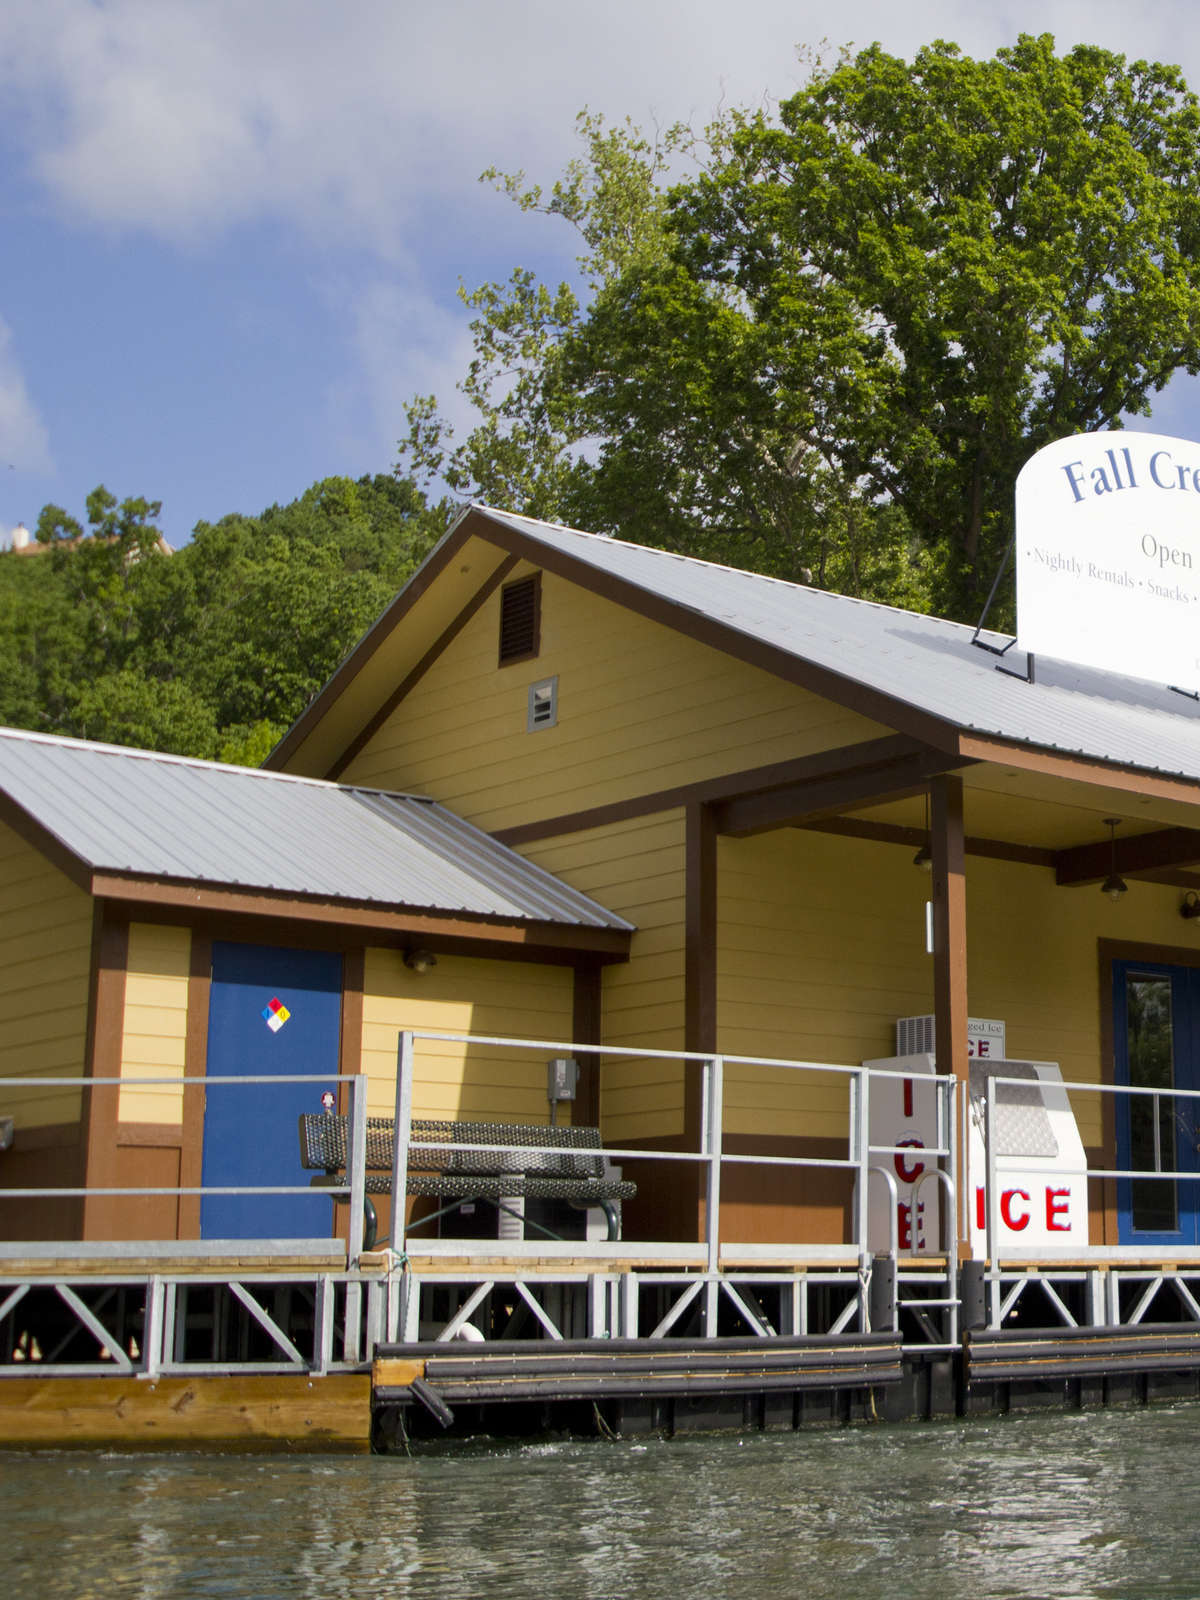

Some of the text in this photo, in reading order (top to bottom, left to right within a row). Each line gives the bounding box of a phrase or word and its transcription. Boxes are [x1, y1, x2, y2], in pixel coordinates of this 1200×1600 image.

[1060, 447, 1140, 503] Fall
[1033, 547, 1083, 577] Nightly
[1087, 562, 1136, 589] Rentals
[1147, 578, 1190, 604] Snacks
[1140, 533, 1193, 568] Open
[976, 1186, 1072, 1232] ICE
